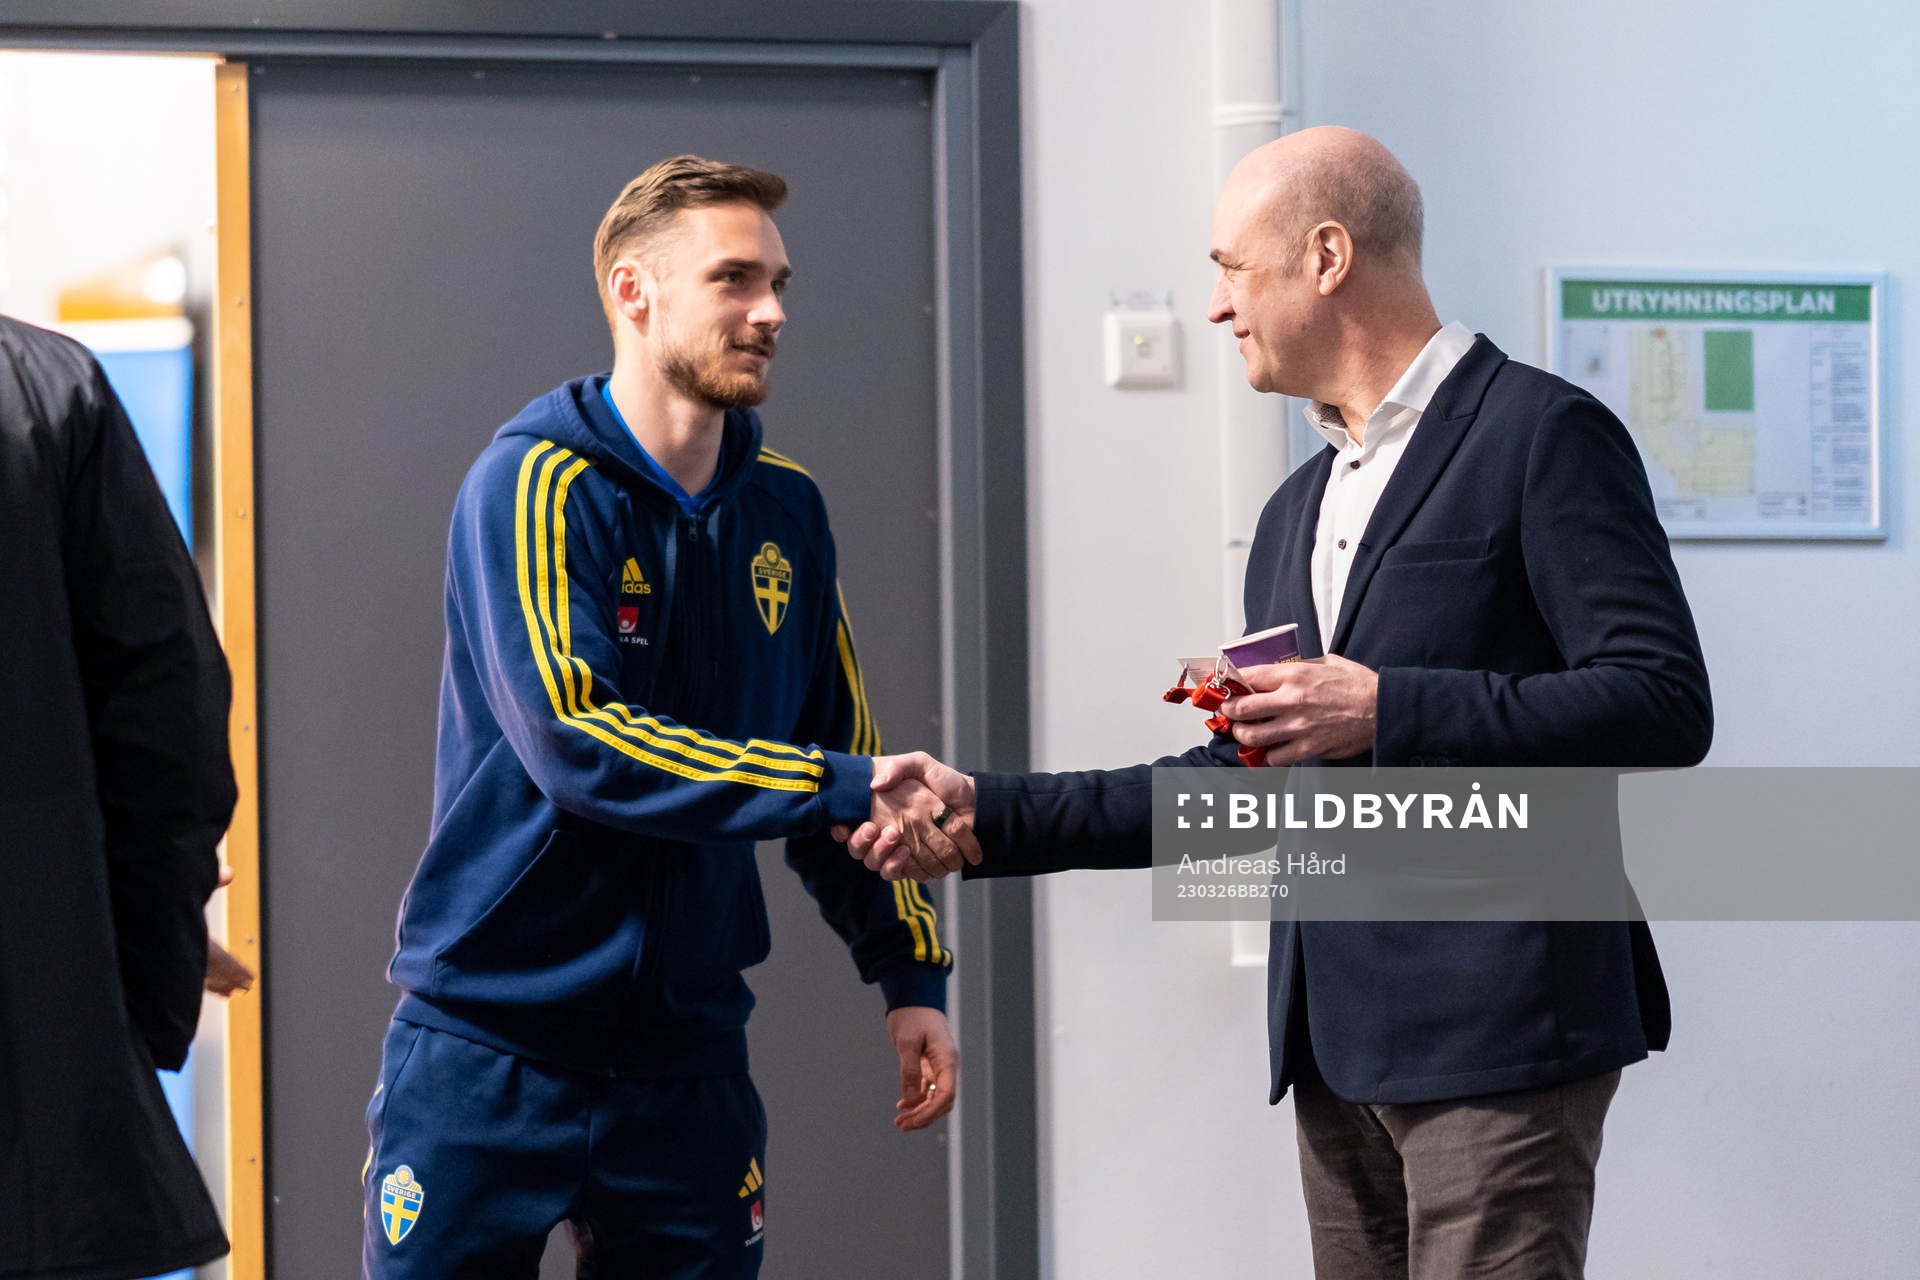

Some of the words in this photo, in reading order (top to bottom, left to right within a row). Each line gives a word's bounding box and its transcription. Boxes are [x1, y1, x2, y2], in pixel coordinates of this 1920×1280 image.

[1592, 288, 1836, 315] UTRYMNINGSPLAN
[758, 566, 788, 580] SVERIGE
[386, 1184, 417, 1200] SVERIGE
